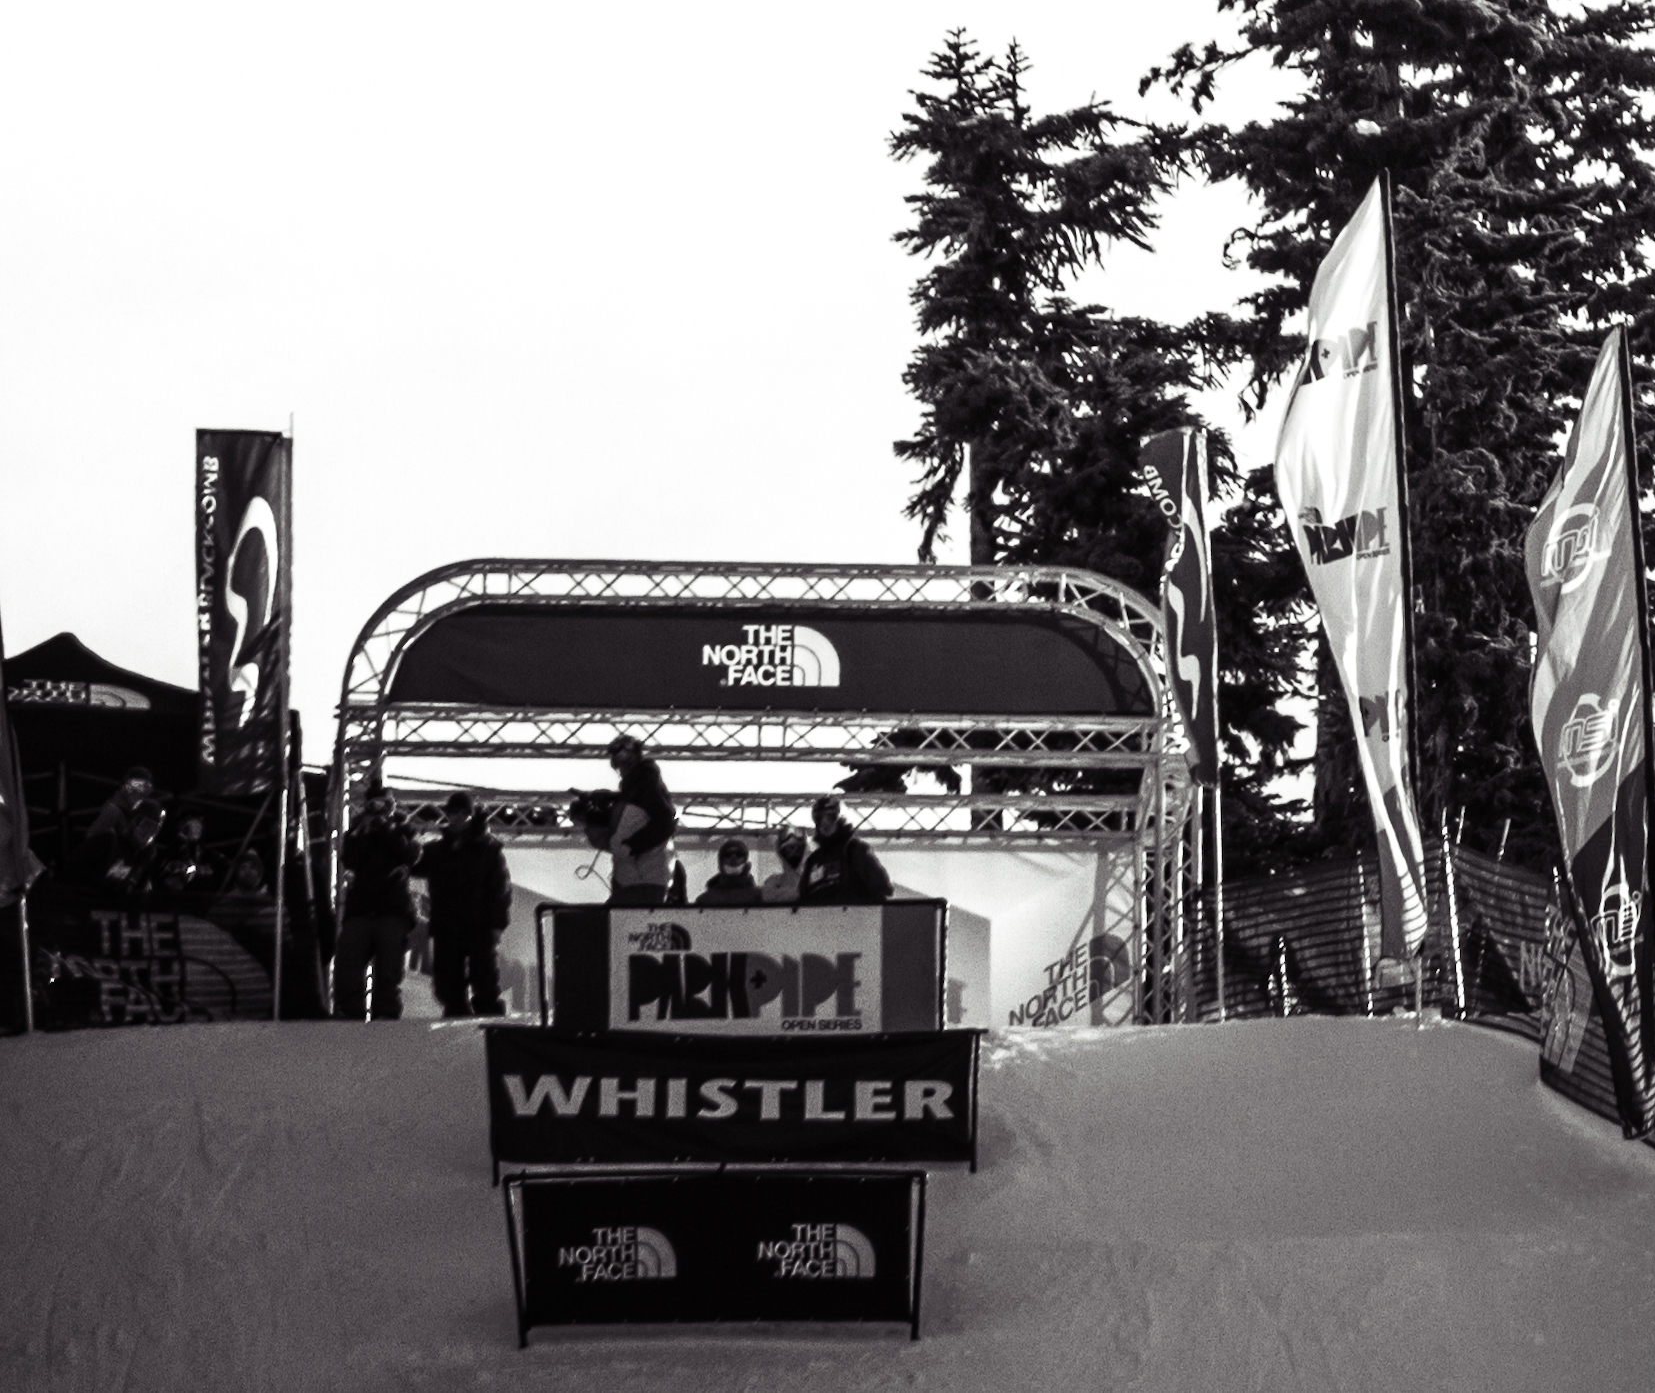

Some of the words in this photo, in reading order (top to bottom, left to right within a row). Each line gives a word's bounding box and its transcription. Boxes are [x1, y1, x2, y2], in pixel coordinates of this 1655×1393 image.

[742, 624, 793, 645] THE
[702, 644, 792, 666] NORTH
[727, 664, 792, 687] FACE
[90, 909, 176, 955] THE
[1043, 942, 1088, 984] THE
[1008, 964, 1088, 1027] NORTH
[782, 1019, 816, 1031] OPEN
[818, 1019, 863, 1031] SERIES
[502, 1074, 955, 1121] WHISTLER
[592, 1226, 636, 1245] THE
[791, 1223, 835, 1243] THE
[558, 1244, 636, 1268] NORTH
[757, 1240, 835, 1262] NORTH
[581, 1262, 636, 1281] FACE
[780, 1259, 835, 1279] FACE
